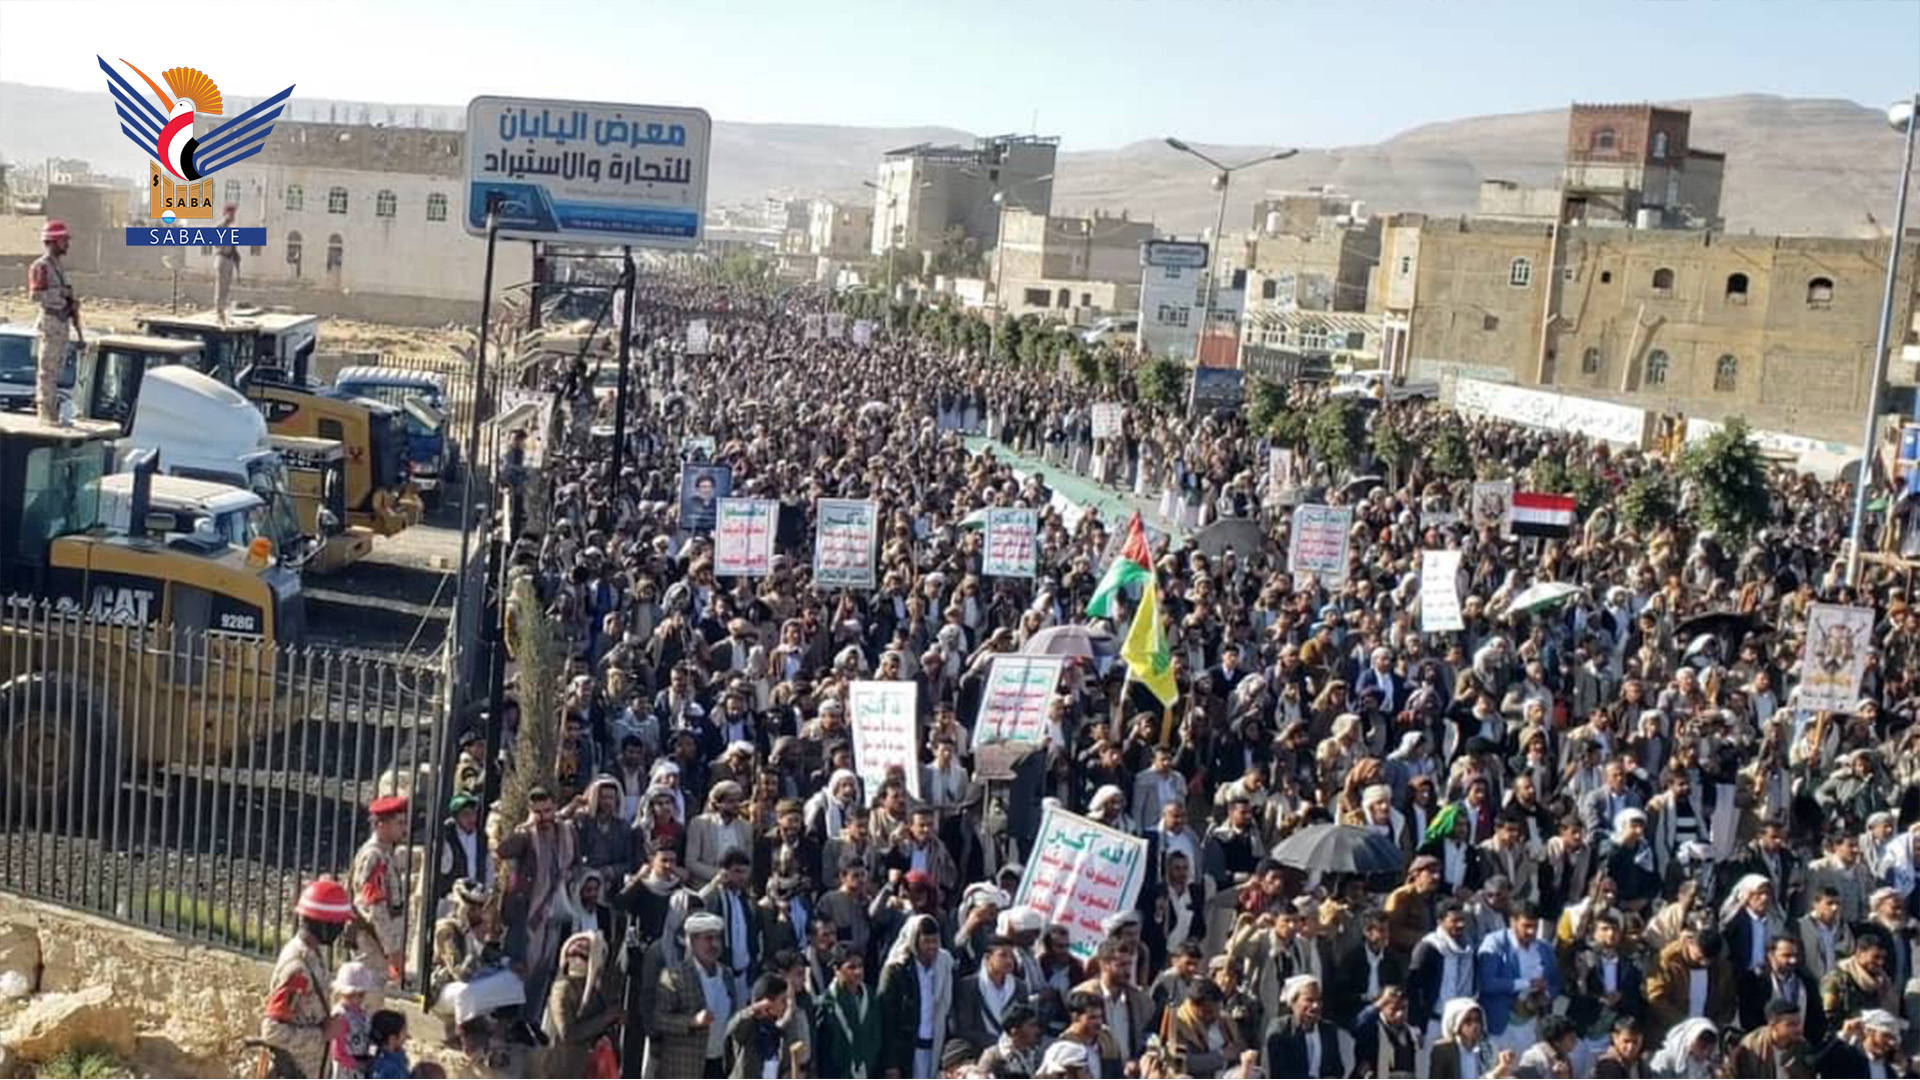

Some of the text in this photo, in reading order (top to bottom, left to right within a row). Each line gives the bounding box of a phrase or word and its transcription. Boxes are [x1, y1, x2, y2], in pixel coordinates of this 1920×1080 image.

[500, 106, 686, 149] معرض اليابان
[483, 146, 691, 188] للتجارة والاستيراد
[89, 586, 154, 626] CAT
[221, 614, 255, 632] 928G
[1048, 830, 1132, 866] الله أكبر
